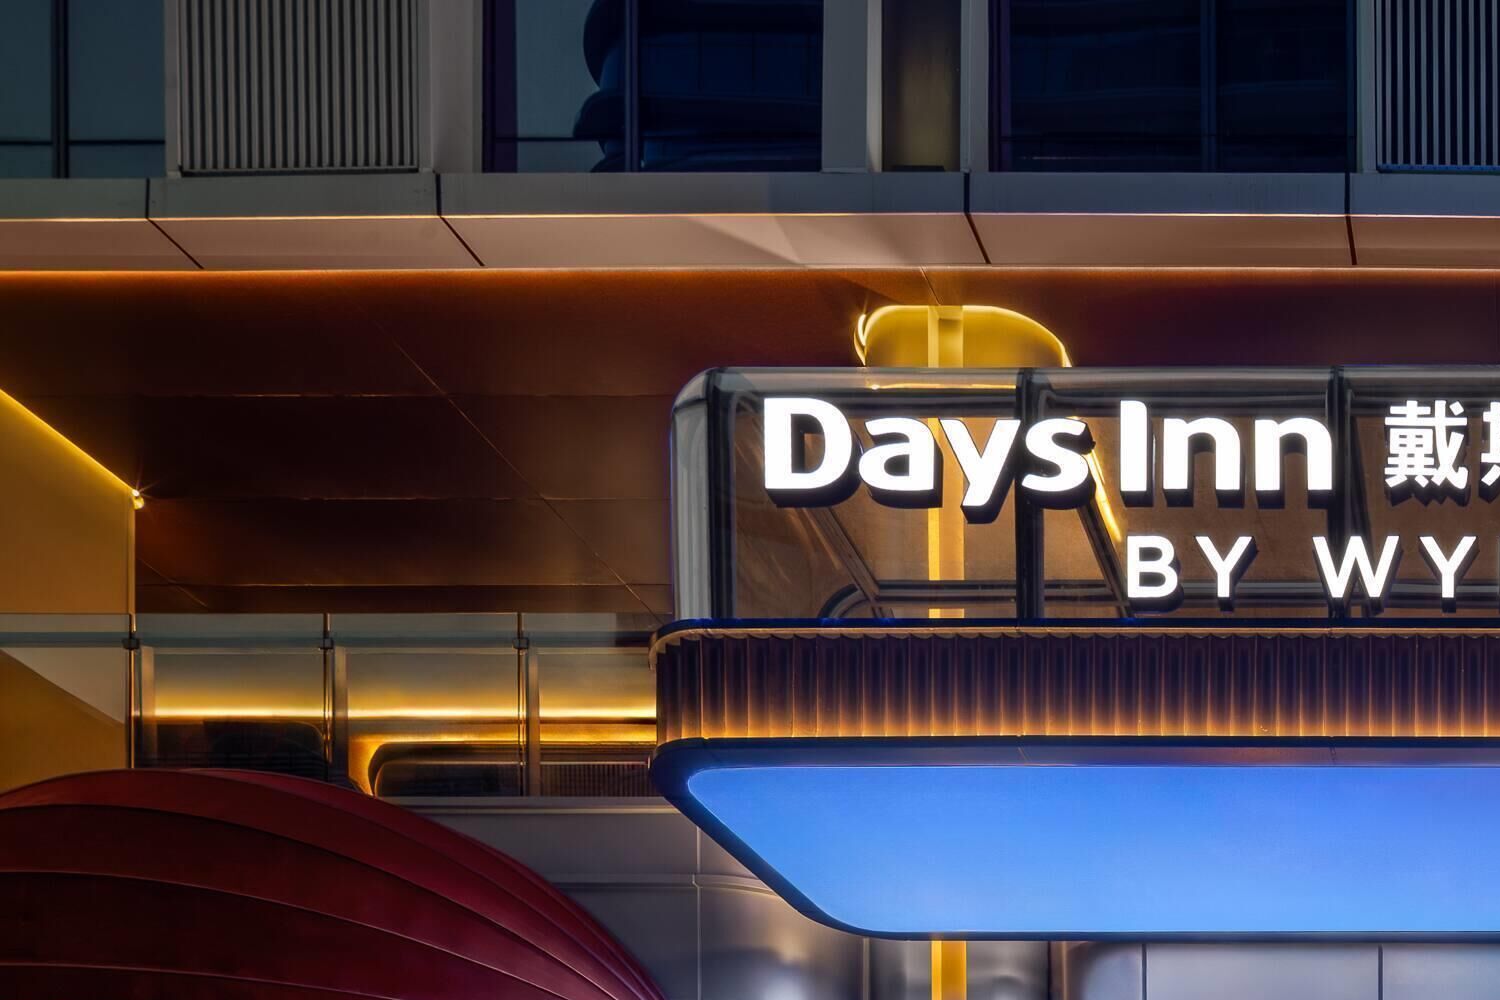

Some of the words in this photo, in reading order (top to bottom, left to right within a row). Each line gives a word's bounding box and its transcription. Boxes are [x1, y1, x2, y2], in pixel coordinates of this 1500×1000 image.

[765, 398, 1088, 506] Days
[1121, 400, 1332, 492] Inn
[1127, 535, 1252, 598] BY
